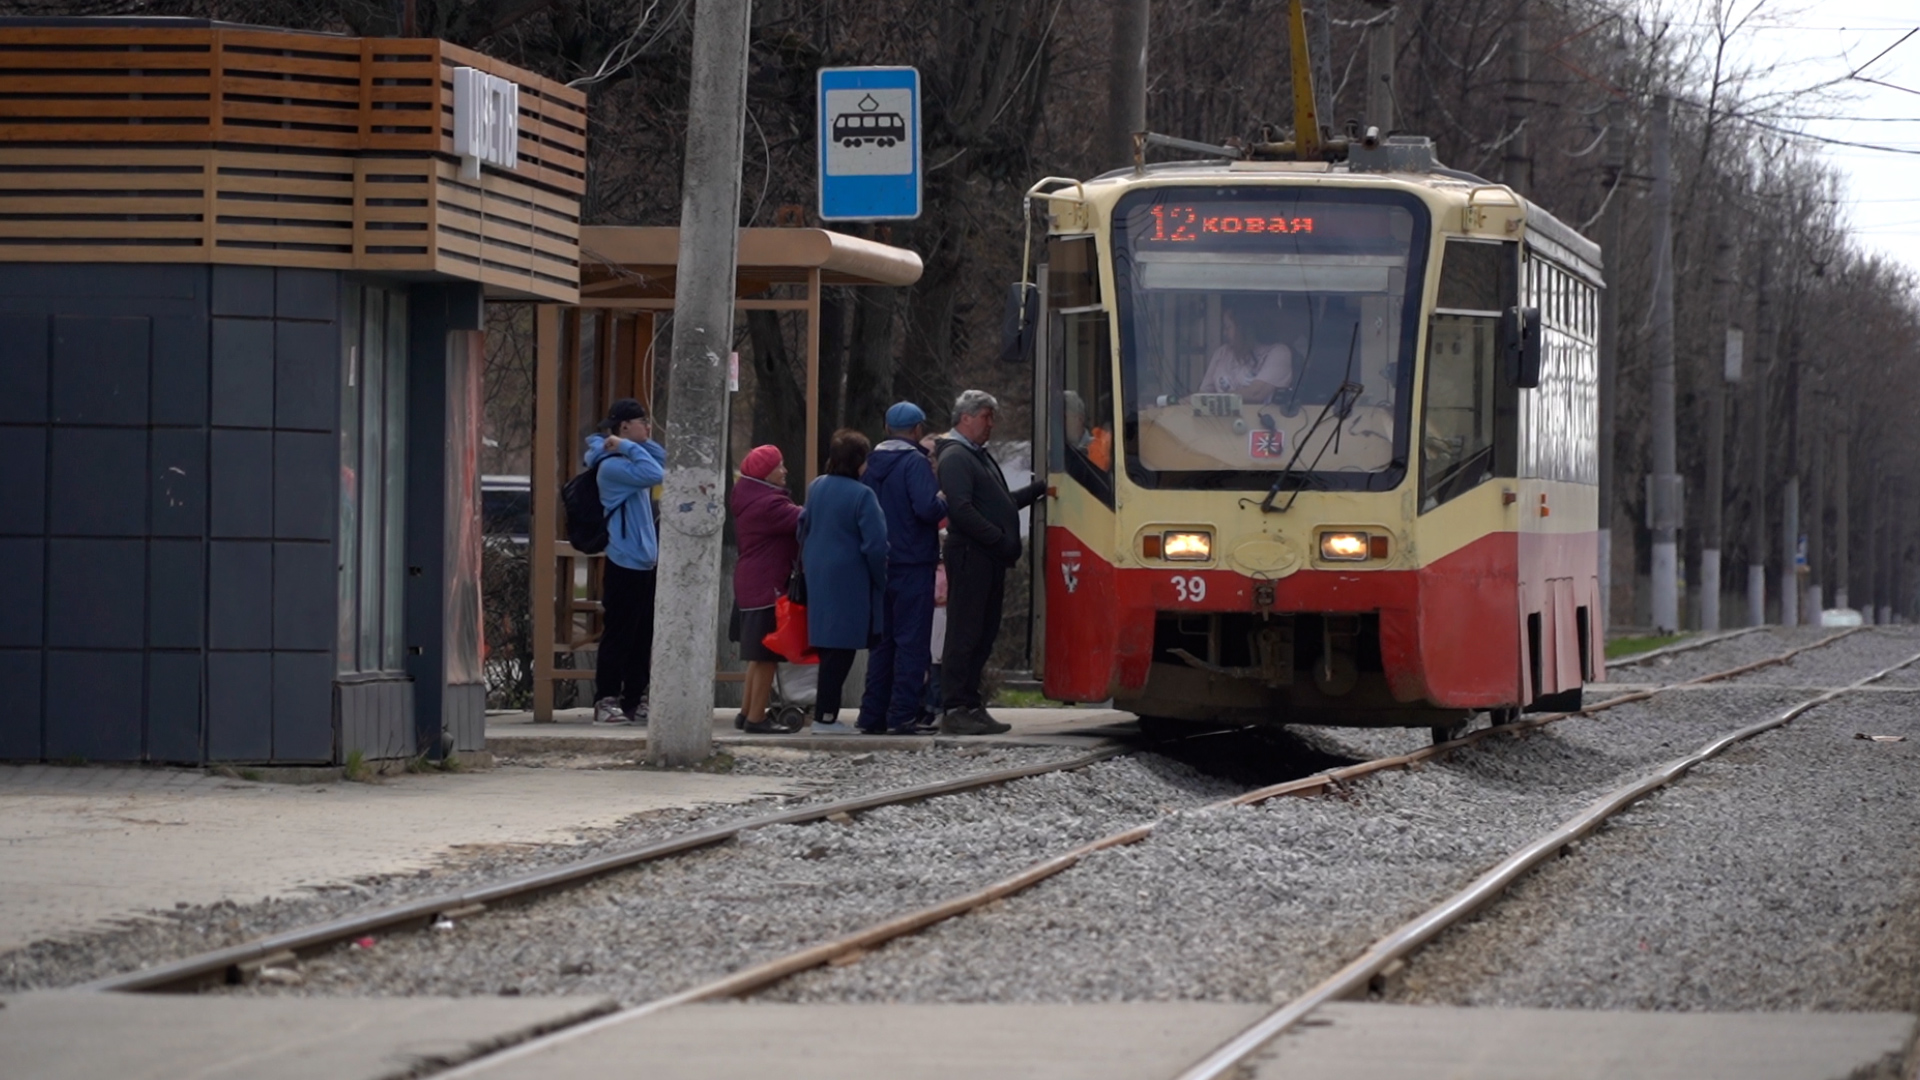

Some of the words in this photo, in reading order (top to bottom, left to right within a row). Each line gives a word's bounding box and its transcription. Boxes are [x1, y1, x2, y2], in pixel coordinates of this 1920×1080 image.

[453, 66, 518, 180] ЦВЕТЫ
[1150, 205, 1196, 241] 12
[1170, 575, 1206, 602] 39
